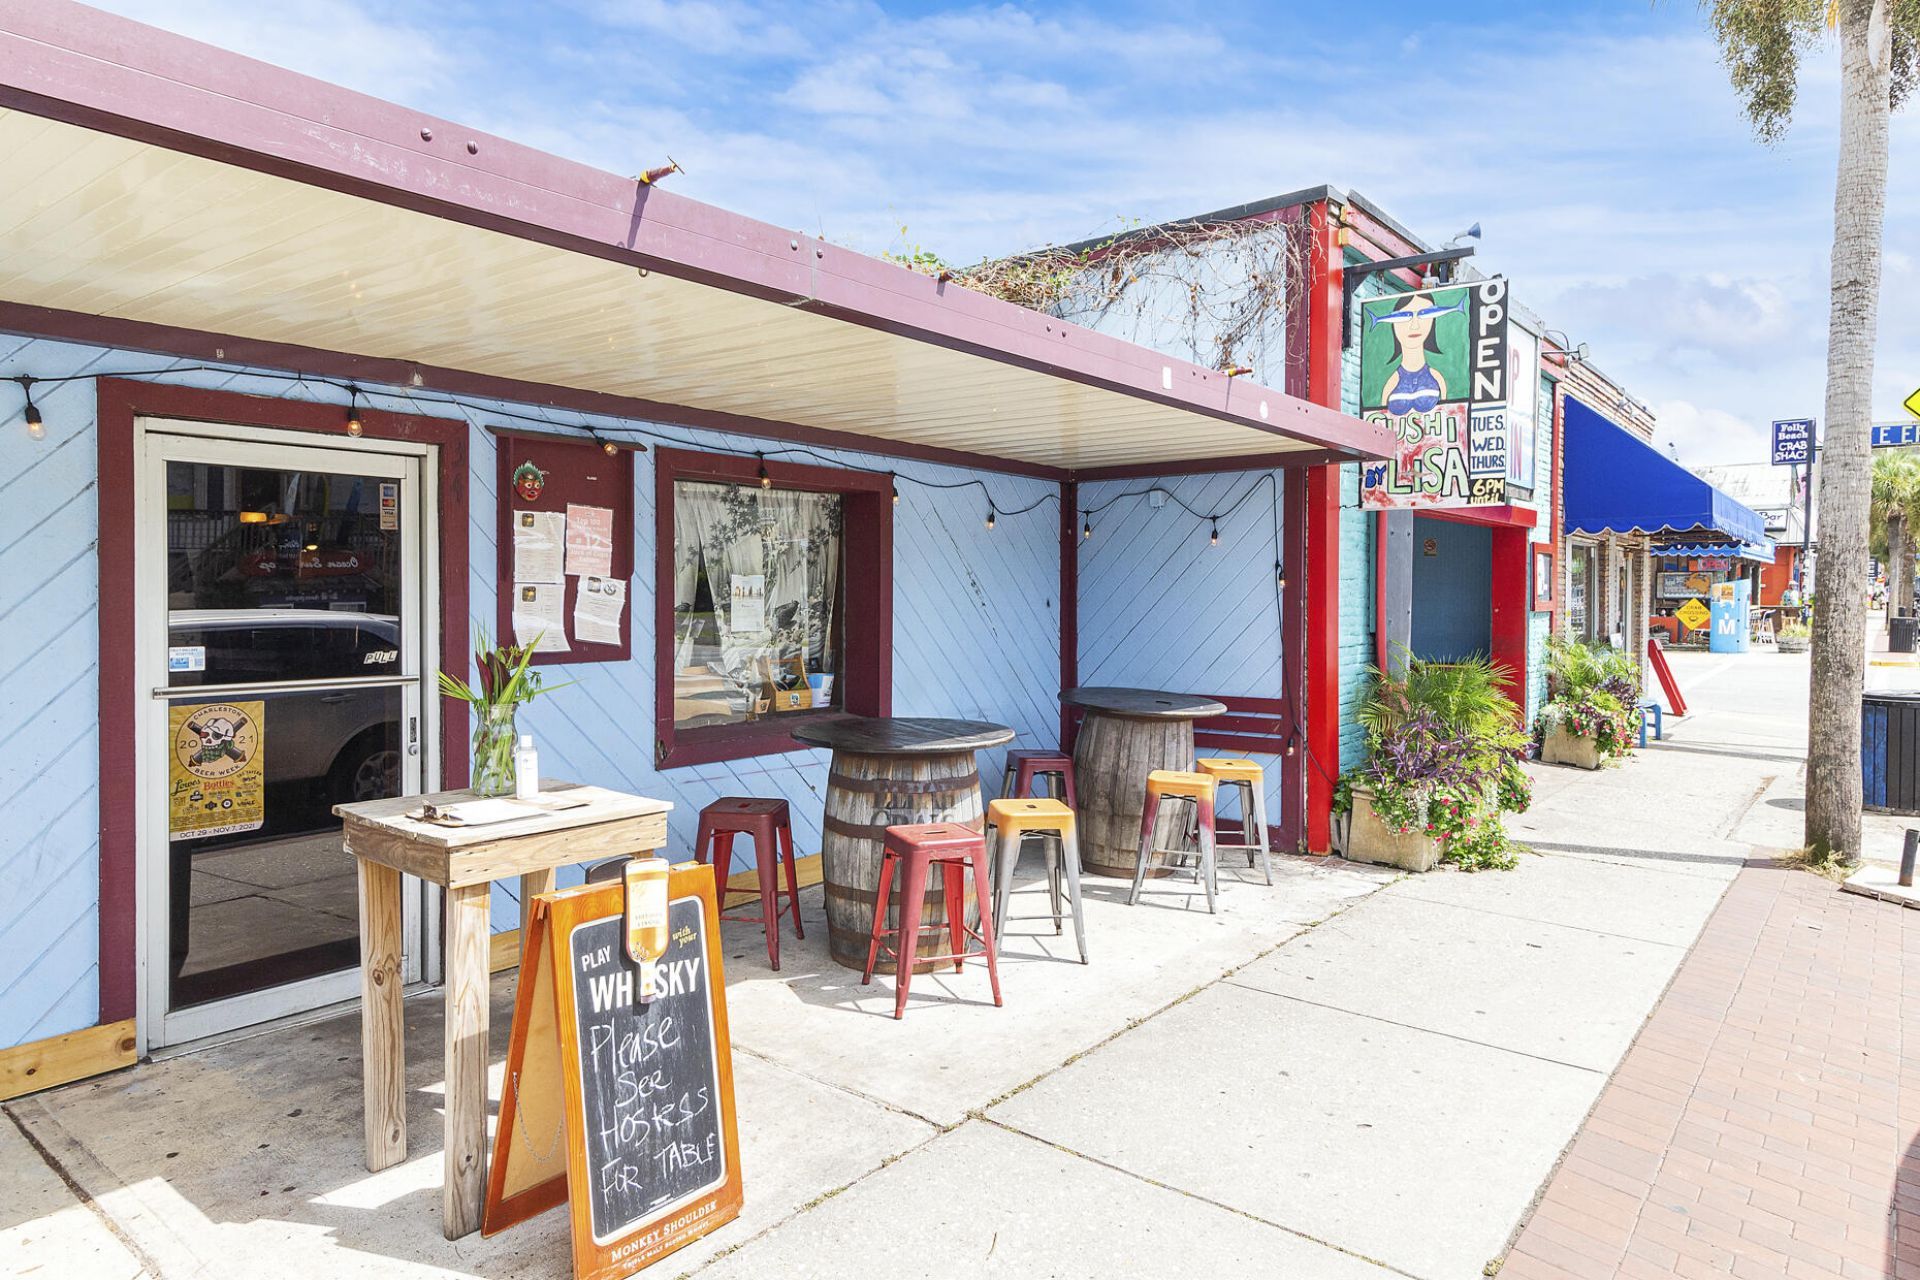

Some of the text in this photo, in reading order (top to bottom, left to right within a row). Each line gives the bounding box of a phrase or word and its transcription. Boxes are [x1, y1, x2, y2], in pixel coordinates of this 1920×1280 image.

[1474, 280, 1506, 400] OPEN
[1471, 415, 1506, 431] TUES.
[1780, 423, 1806, 433] Folly
[1472, 435, 1506, 452] WED.
[1778, 431, 1808, 441] Beach
[1778, 441, 1808, 451] CRAB
[1471, 454, 1506, 471] THURS.
[1364, 464, 1387, 489] BY
[1700, 559, 1729, 571] OPEN
[363, 650, 398, 665] PULL
[193, 706, 243, 721] CHARLESTON
[194, 764, 241, 777] BEER WEEK
[203, 780, 235, 791] Bottles
[180, 831, 195, 839] OCT
[213, 826, 230, 834] NOV
[672, 925, 691, 941] with
[679, 931, 698, 949] your
[581, 945, 612, 972] PLAY
[589, 957, 701, 1014] WHSKY
[611, 1200, 718, 1263] MONKEY SHOULDER
